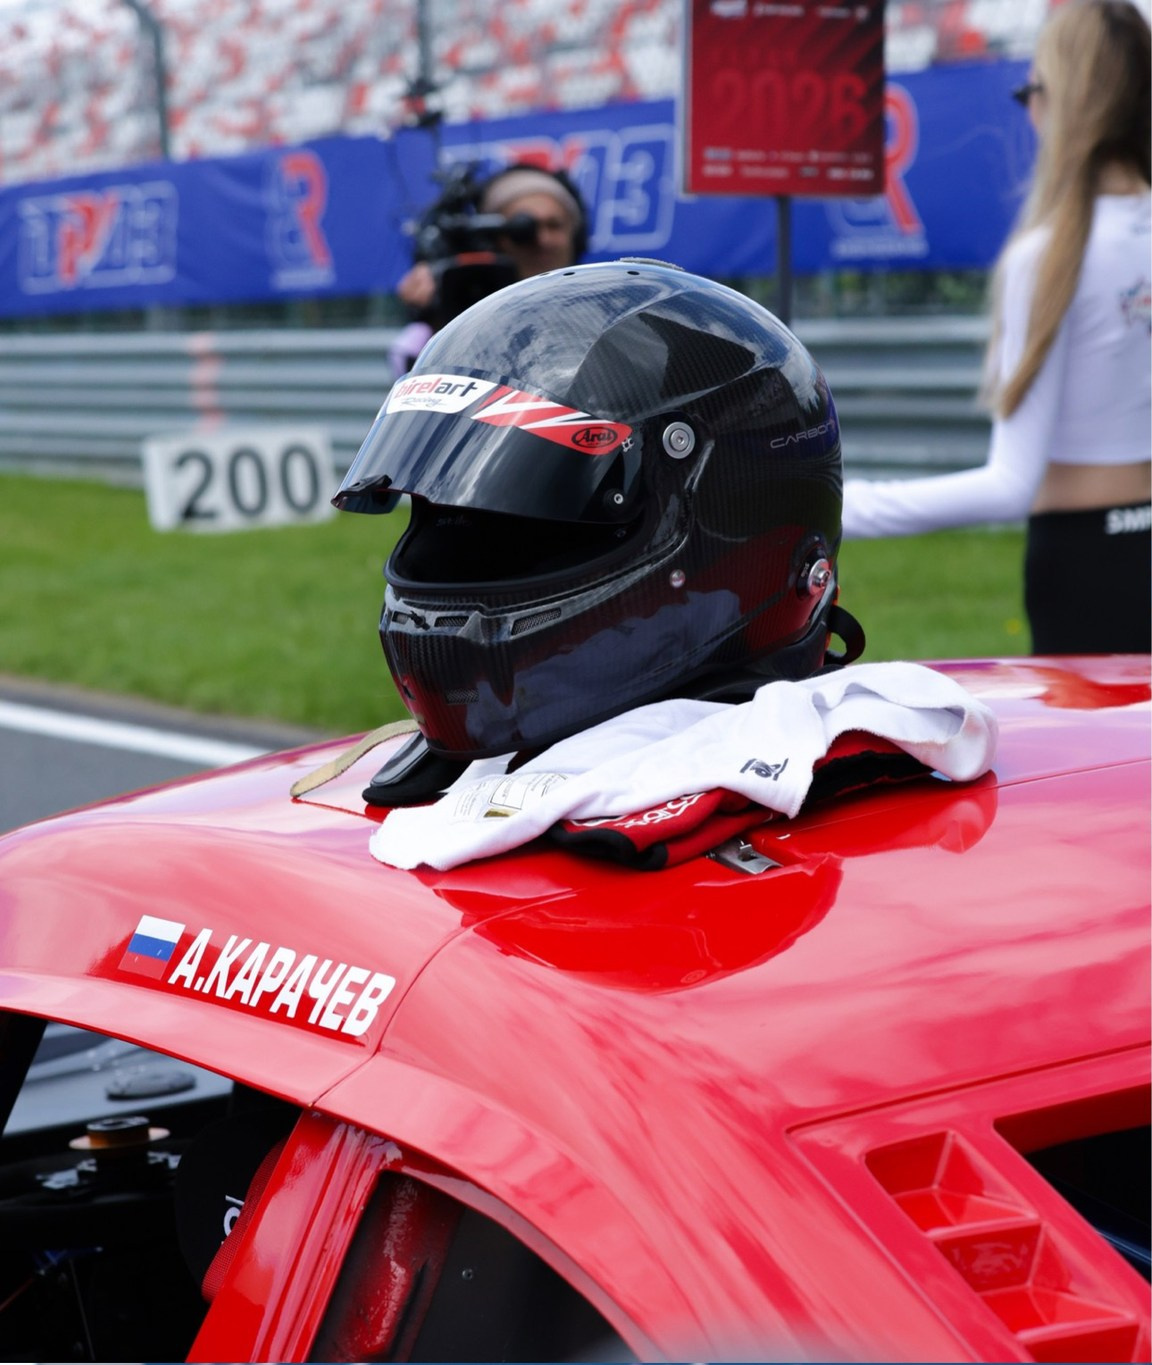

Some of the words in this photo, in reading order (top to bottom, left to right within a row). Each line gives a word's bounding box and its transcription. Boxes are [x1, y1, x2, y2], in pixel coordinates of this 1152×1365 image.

[575, 429, 612, 444] Arai
[173, 445, 323, 521] 200
[167, 927, 397, 1037] А.КАРАЧЕВ
